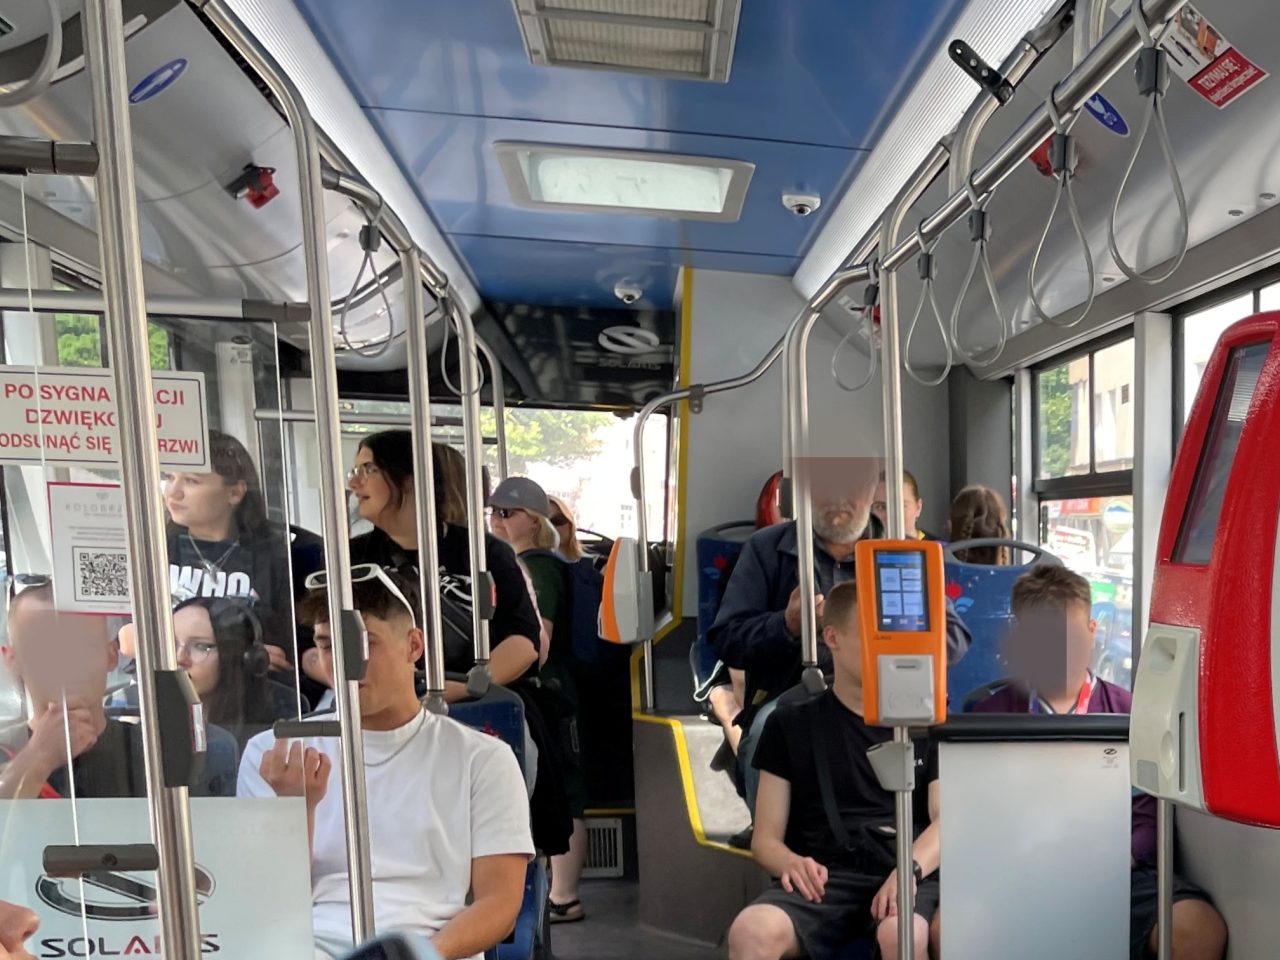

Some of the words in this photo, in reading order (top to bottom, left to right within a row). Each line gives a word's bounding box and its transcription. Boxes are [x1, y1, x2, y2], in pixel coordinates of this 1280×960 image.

[5, 384, 33, 399] PO
[40, 384, 185, 405] SYGNACJI
[25, 409, 162, 430] DZWIĘKJ
[86, 436, 112, 454] SIĘ
[157, 438, 199, 454] RZWI
[40, 934, 220, 958] SOLAS
